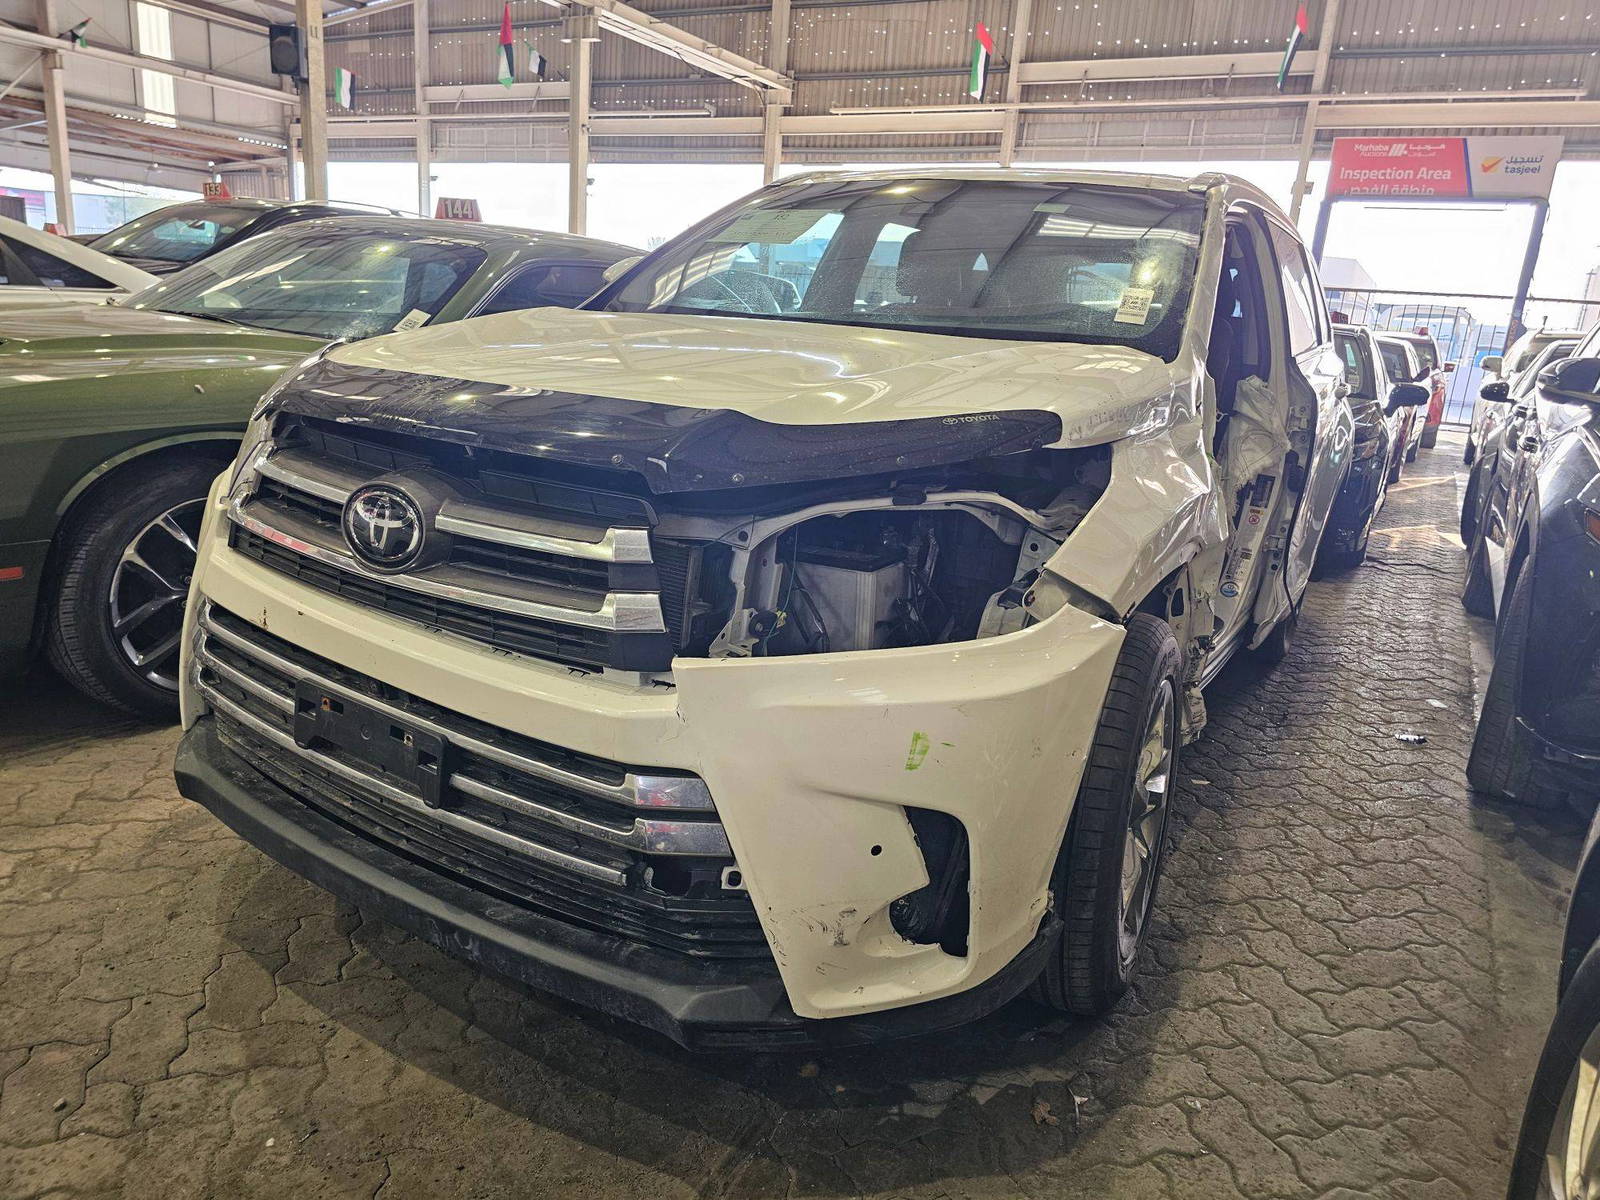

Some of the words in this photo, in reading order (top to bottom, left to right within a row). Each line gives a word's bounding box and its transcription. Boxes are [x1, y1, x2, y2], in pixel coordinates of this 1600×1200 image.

[1353, 143, 1389, 152] Marhaba
[1505, 154, 1544, 164] تسجيل
[1340, 167, 1414, 182] Inspection
[1416, 167, 1452, 180] Area
[1504, 164, 1541, 176] tasjeel
[444, 199, 472, 218] 144
[958, 414, 1000, 423] TOYOTA
